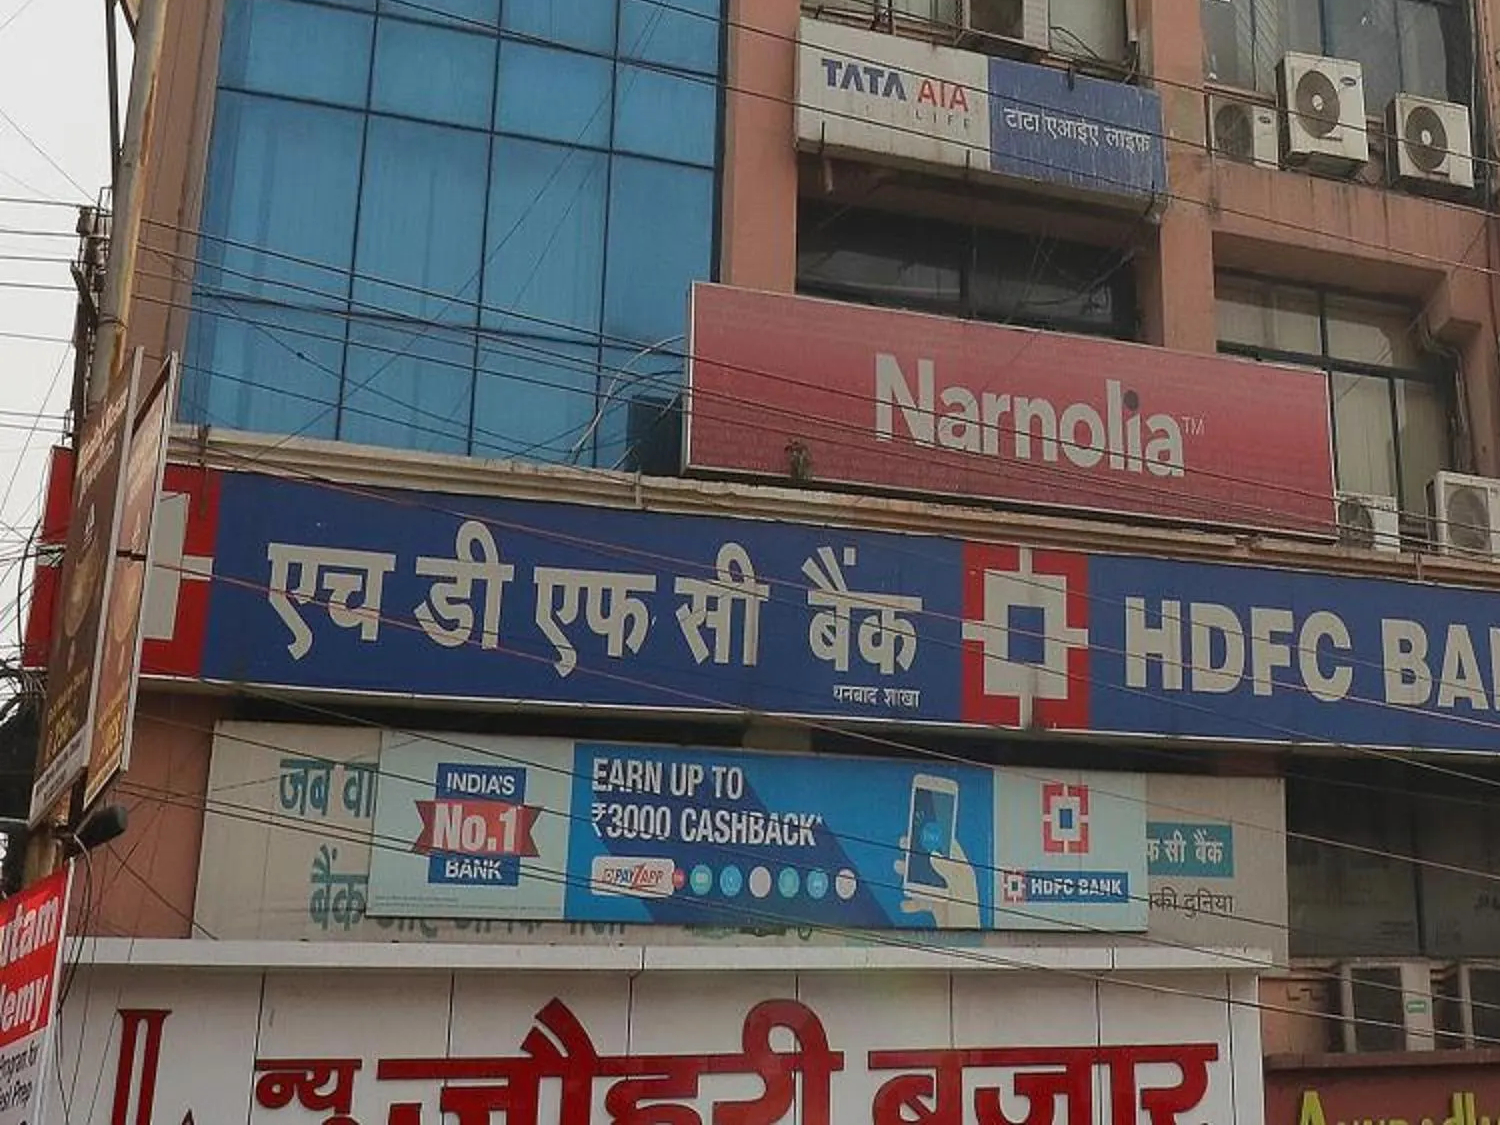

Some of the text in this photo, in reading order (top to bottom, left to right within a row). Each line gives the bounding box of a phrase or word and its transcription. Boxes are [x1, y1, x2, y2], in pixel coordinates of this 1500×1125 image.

[821, 58, 968, 112] TATA AIA
[1004, 106, 1039, 132] टाटा
[875, 353, 1184, 477] Narnolia
[267, 520, 923, 678] एच डी एफ सी बैंक
[1124, 597, 1353, 702] HDFC
[446, 772, 516, 795] INDIA'S
[592, 758, 744, 800] EARN UP TO
[433, 803, 518, 853] No.1
[445, 858, 502, 880] BANK
[1031, 877, 1124, 897] HDFC BANK
[0, 974, 48, 1032] emy
